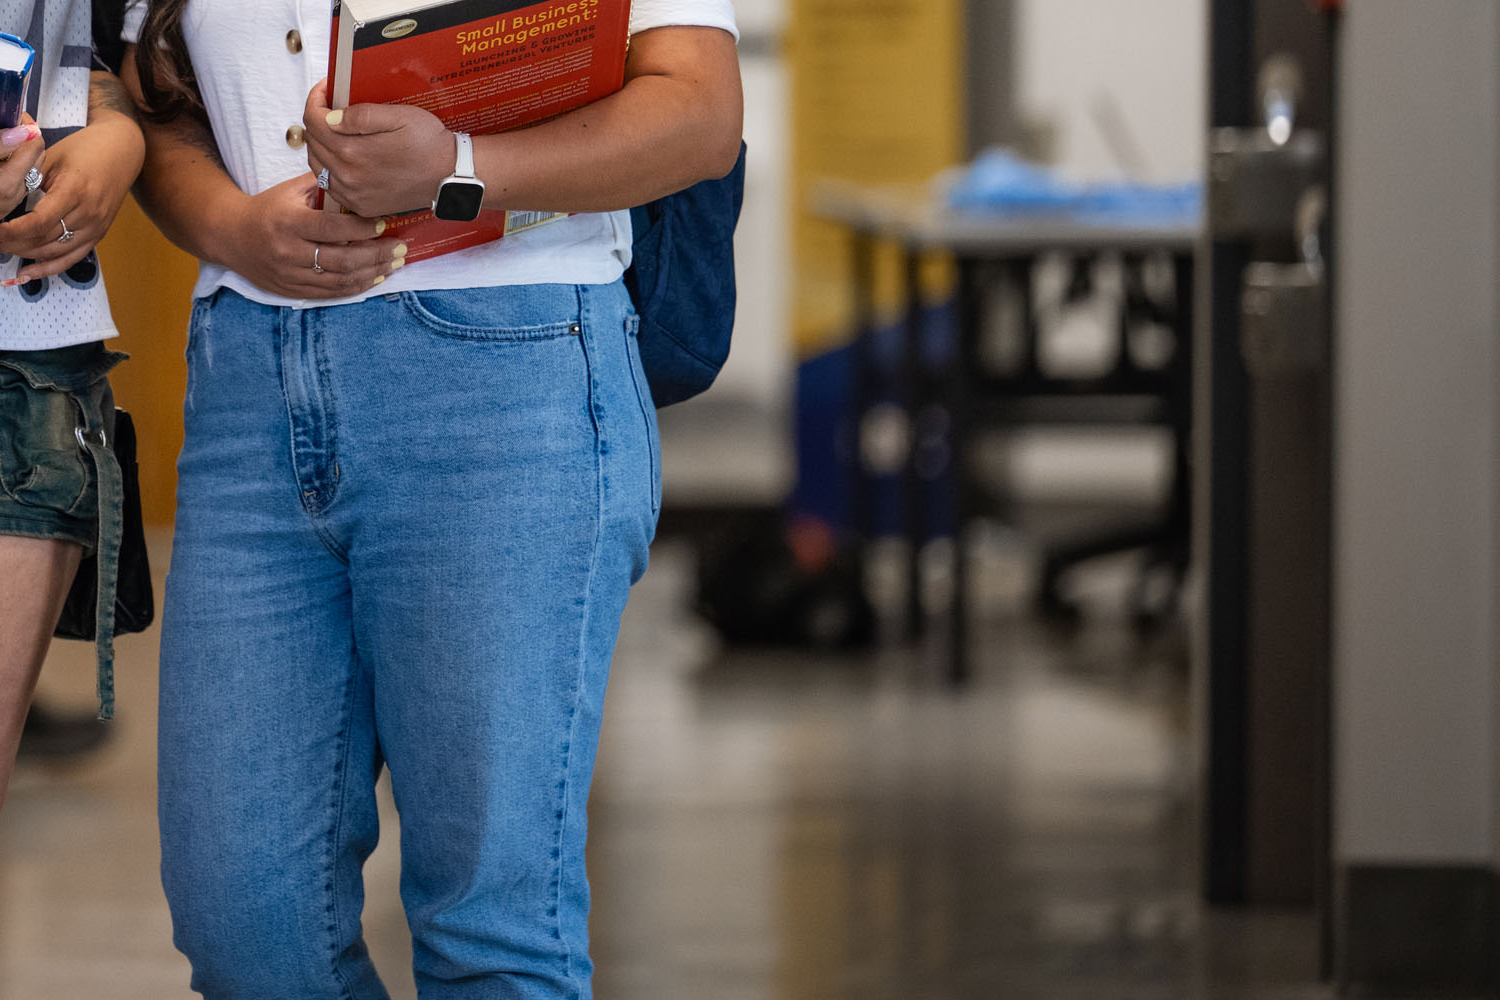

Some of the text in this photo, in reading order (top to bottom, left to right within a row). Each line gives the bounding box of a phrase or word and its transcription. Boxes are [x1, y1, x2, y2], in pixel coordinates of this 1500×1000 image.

[455, 18, 506, 45] Small
[459, 43, 526, 68] LAUNCHING
[542, 24, 596, 46] GROWING
[461, 9, 598, 56] Management:
[539, 32, 596, 54] VENTURES
